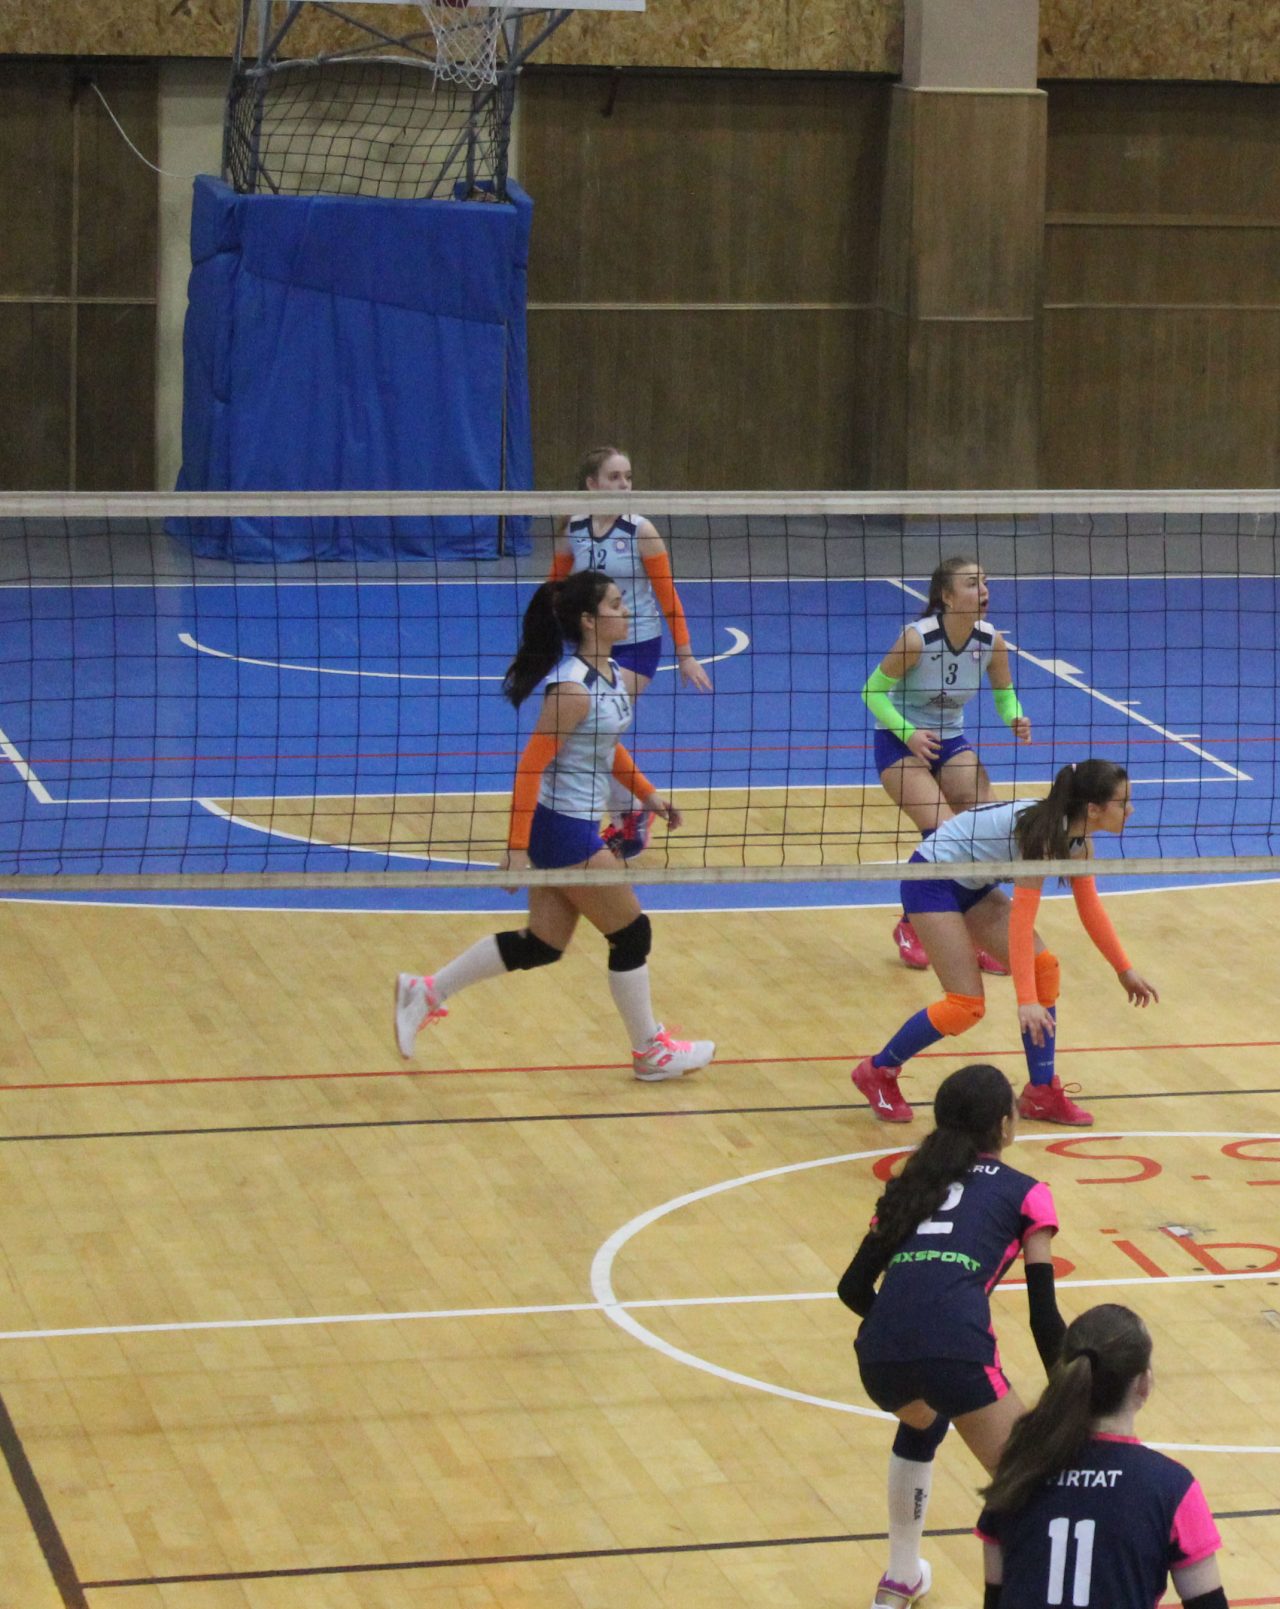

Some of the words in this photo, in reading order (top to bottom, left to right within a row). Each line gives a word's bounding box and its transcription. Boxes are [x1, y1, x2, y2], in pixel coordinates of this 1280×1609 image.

[588, 549, 608, 570] 12
[946, 663, 959, 685] 3
[916, 1181, 964, 1235] 2
[1054, 1469, 1123, 1488] IRTAT
[1047, 1517, 1096, 1607] 11
